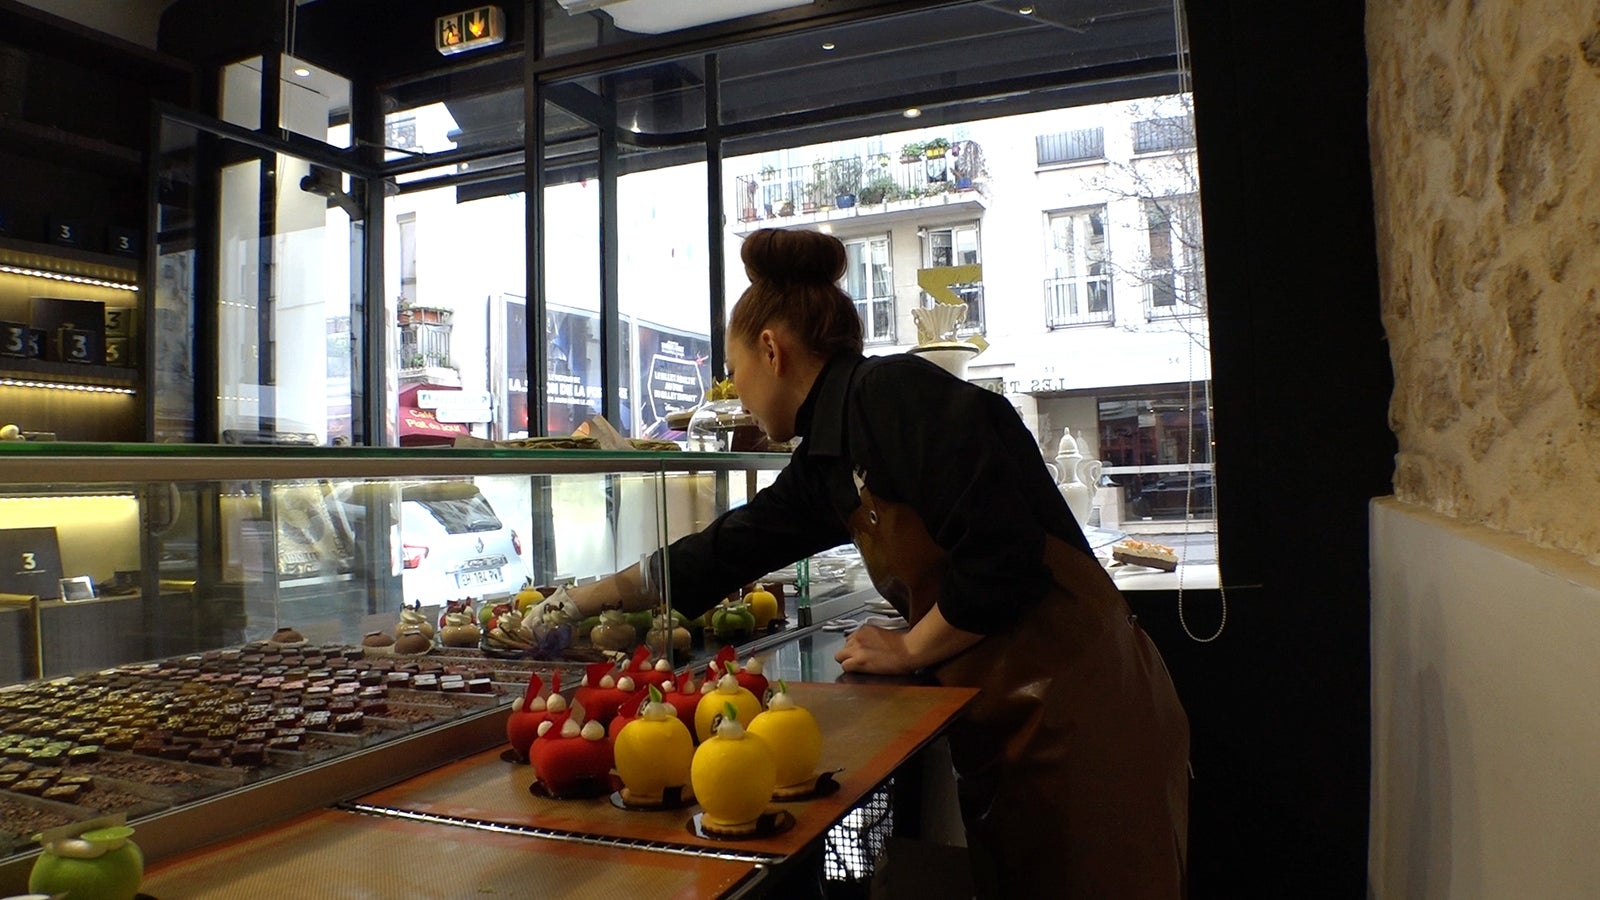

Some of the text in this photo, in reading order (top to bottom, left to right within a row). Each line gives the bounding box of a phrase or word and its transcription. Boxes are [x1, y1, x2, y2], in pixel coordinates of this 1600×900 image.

[60, 224, 71, 239] 3
[119, 236, 129, 249] 3
[106, 311, 121, 329] 3
[6, 327, 23, 352] 3
[71, 334, 88, 358] 3
[574, 384, 586, 398] LA
[405, 418, 429, 429] Plat
[22, 552, 37, 570] 3
